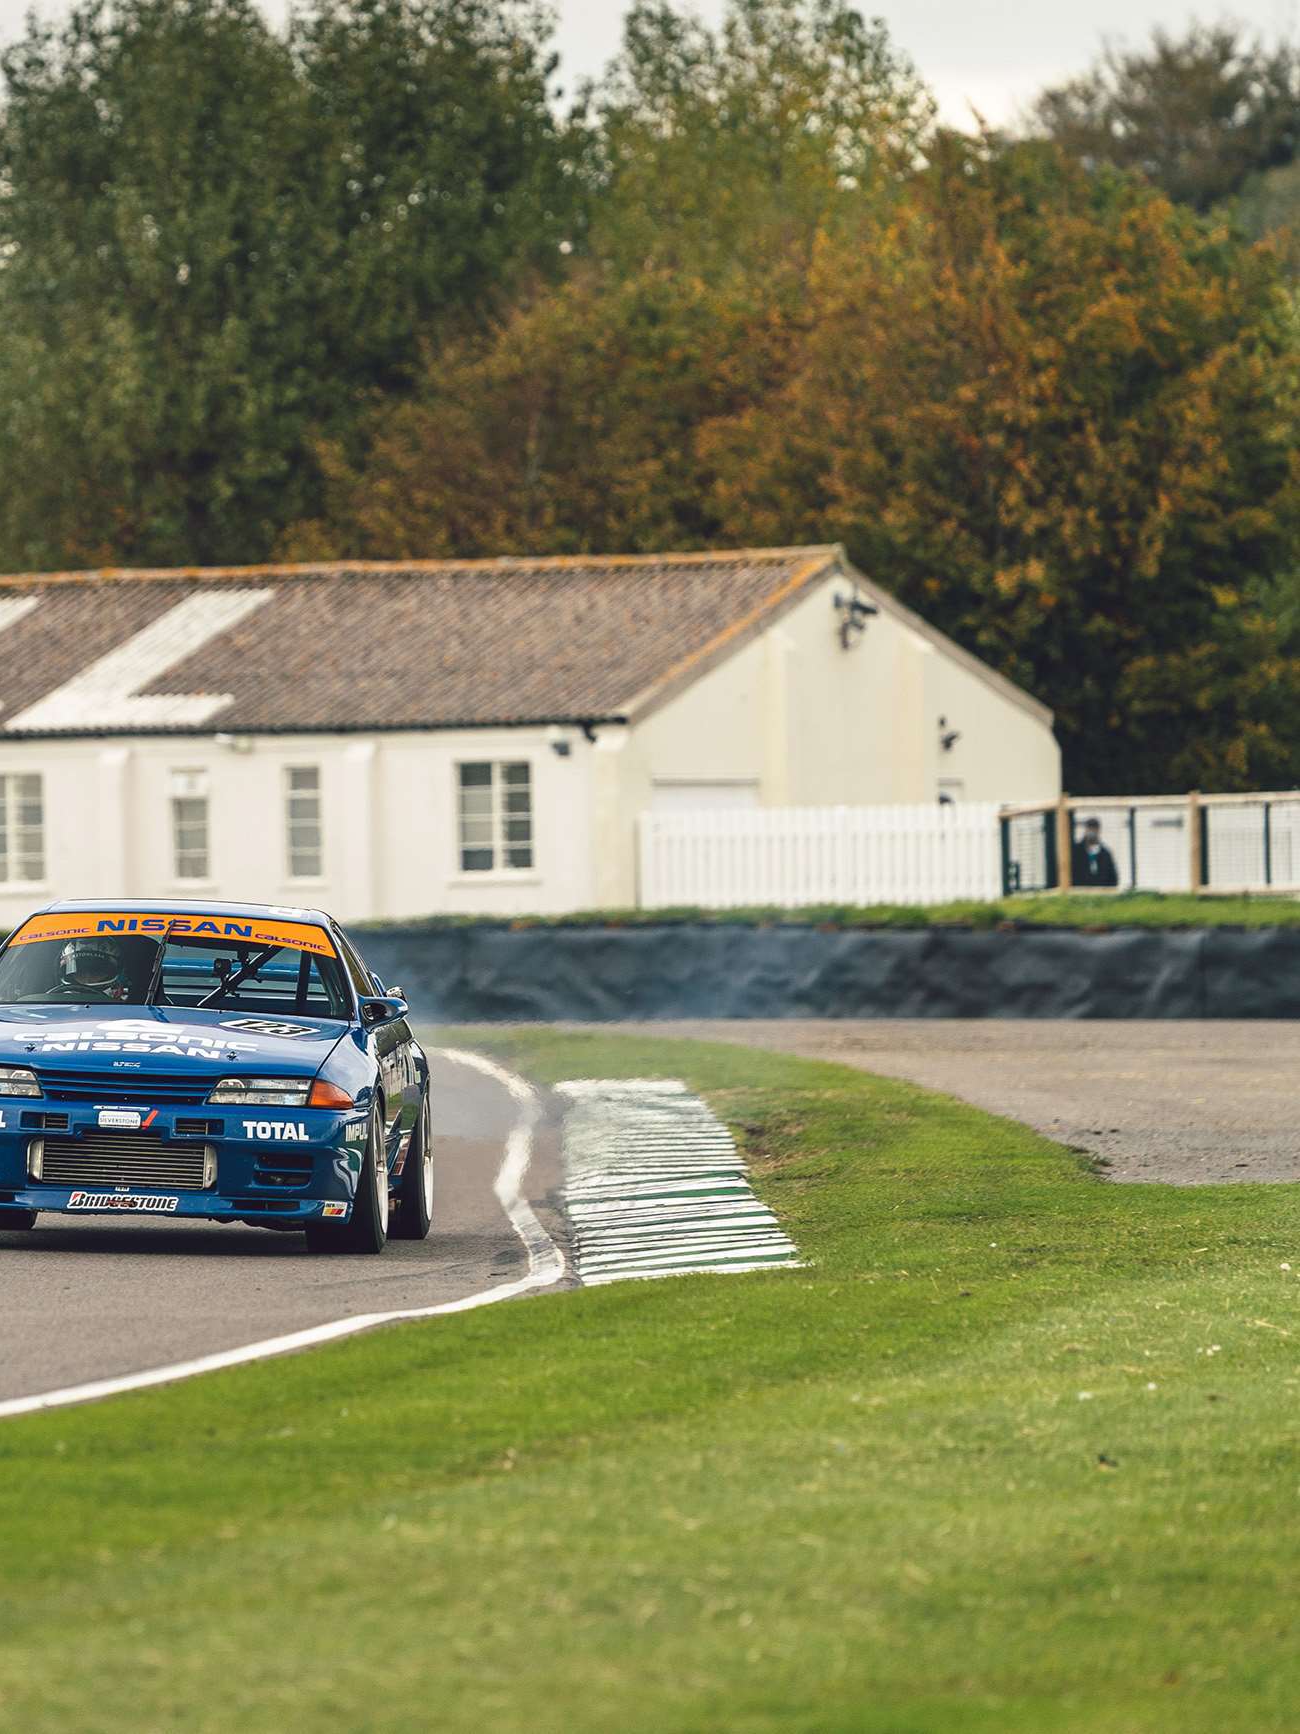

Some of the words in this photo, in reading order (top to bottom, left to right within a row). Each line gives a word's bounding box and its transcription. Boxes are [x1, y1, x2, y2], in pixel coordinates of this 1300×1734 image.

[97, 918, 252, 937] NISSAN
[230, 1019, 313, 1035] 123
[41, 1041, 220, 1058] NISSAN
[243, 1121, 309, 1140] TOTAL
[68, 1192, 178, 1210] BRIDGESTONE
